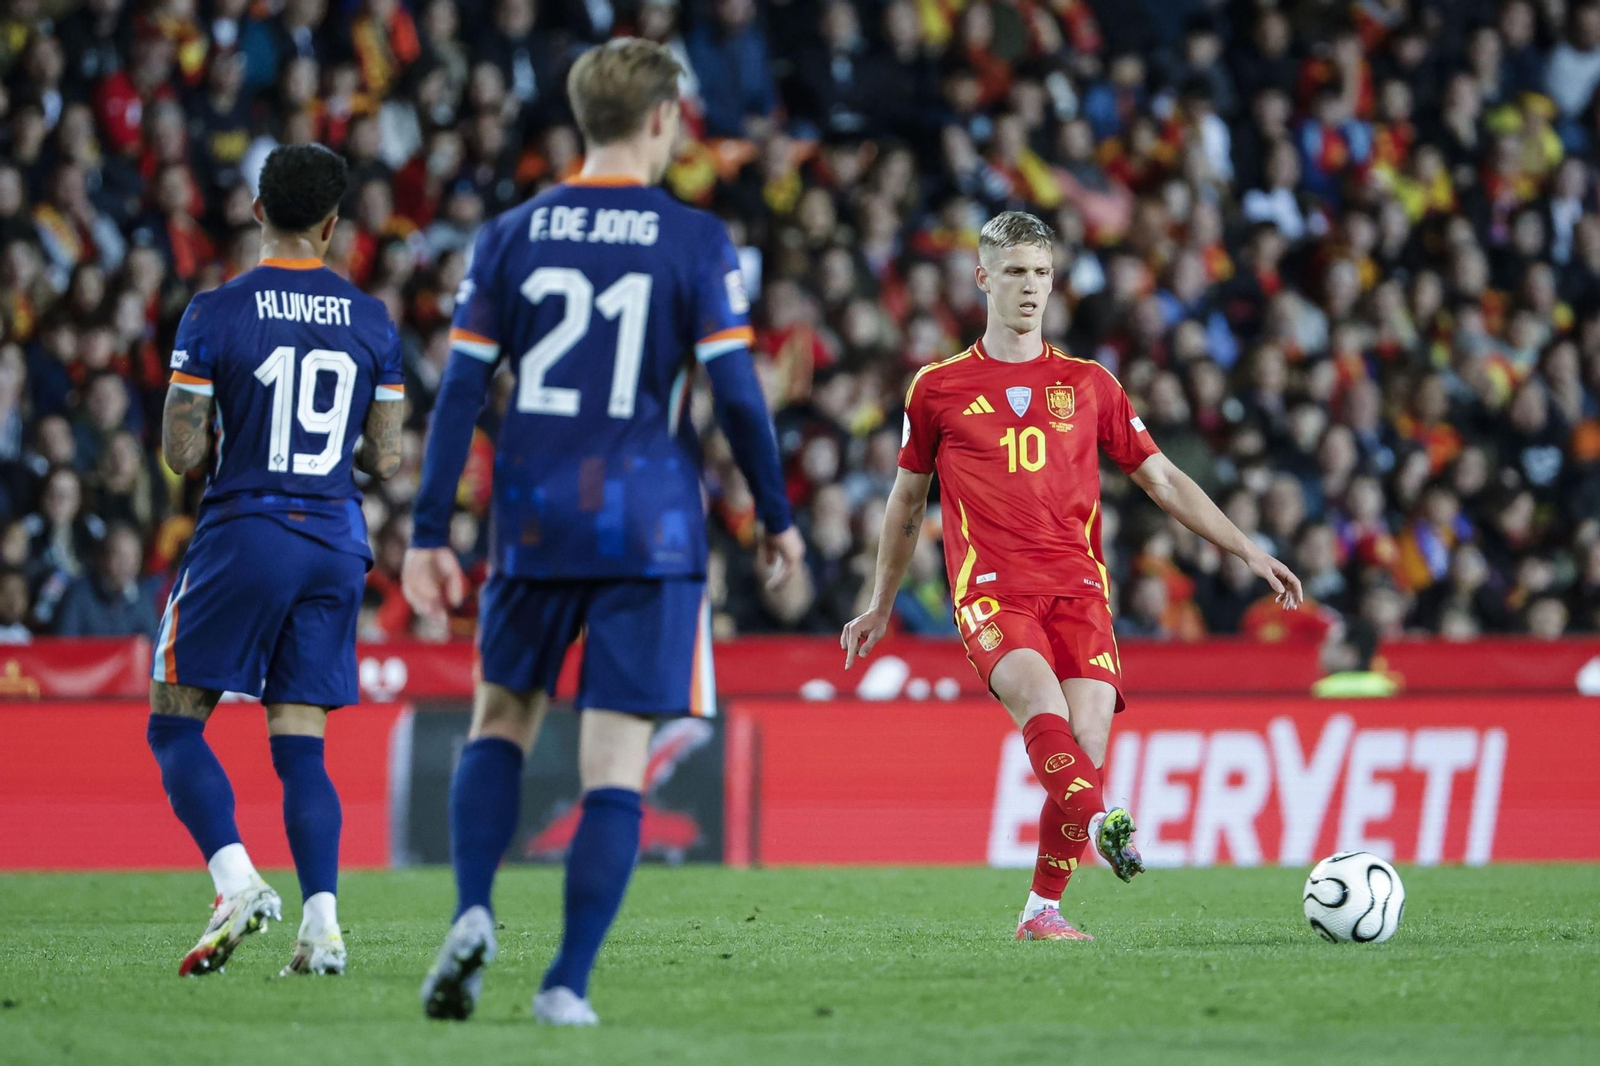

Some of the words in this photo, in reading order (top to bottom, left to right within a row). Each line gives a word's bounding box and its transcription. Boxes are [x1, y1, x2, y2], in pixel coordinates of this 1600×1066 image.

[587, 208, 660, 246] JONG
[255, 290, 352, 327] KLUIVERT
[518, 267, 653, 419] 21
[254, 345, 358, 476] 19
[1000, 425, 1047, 473] 10
[960, 596, 1001, 634] 10
[987, 713, 1508, 868] EERYETI
